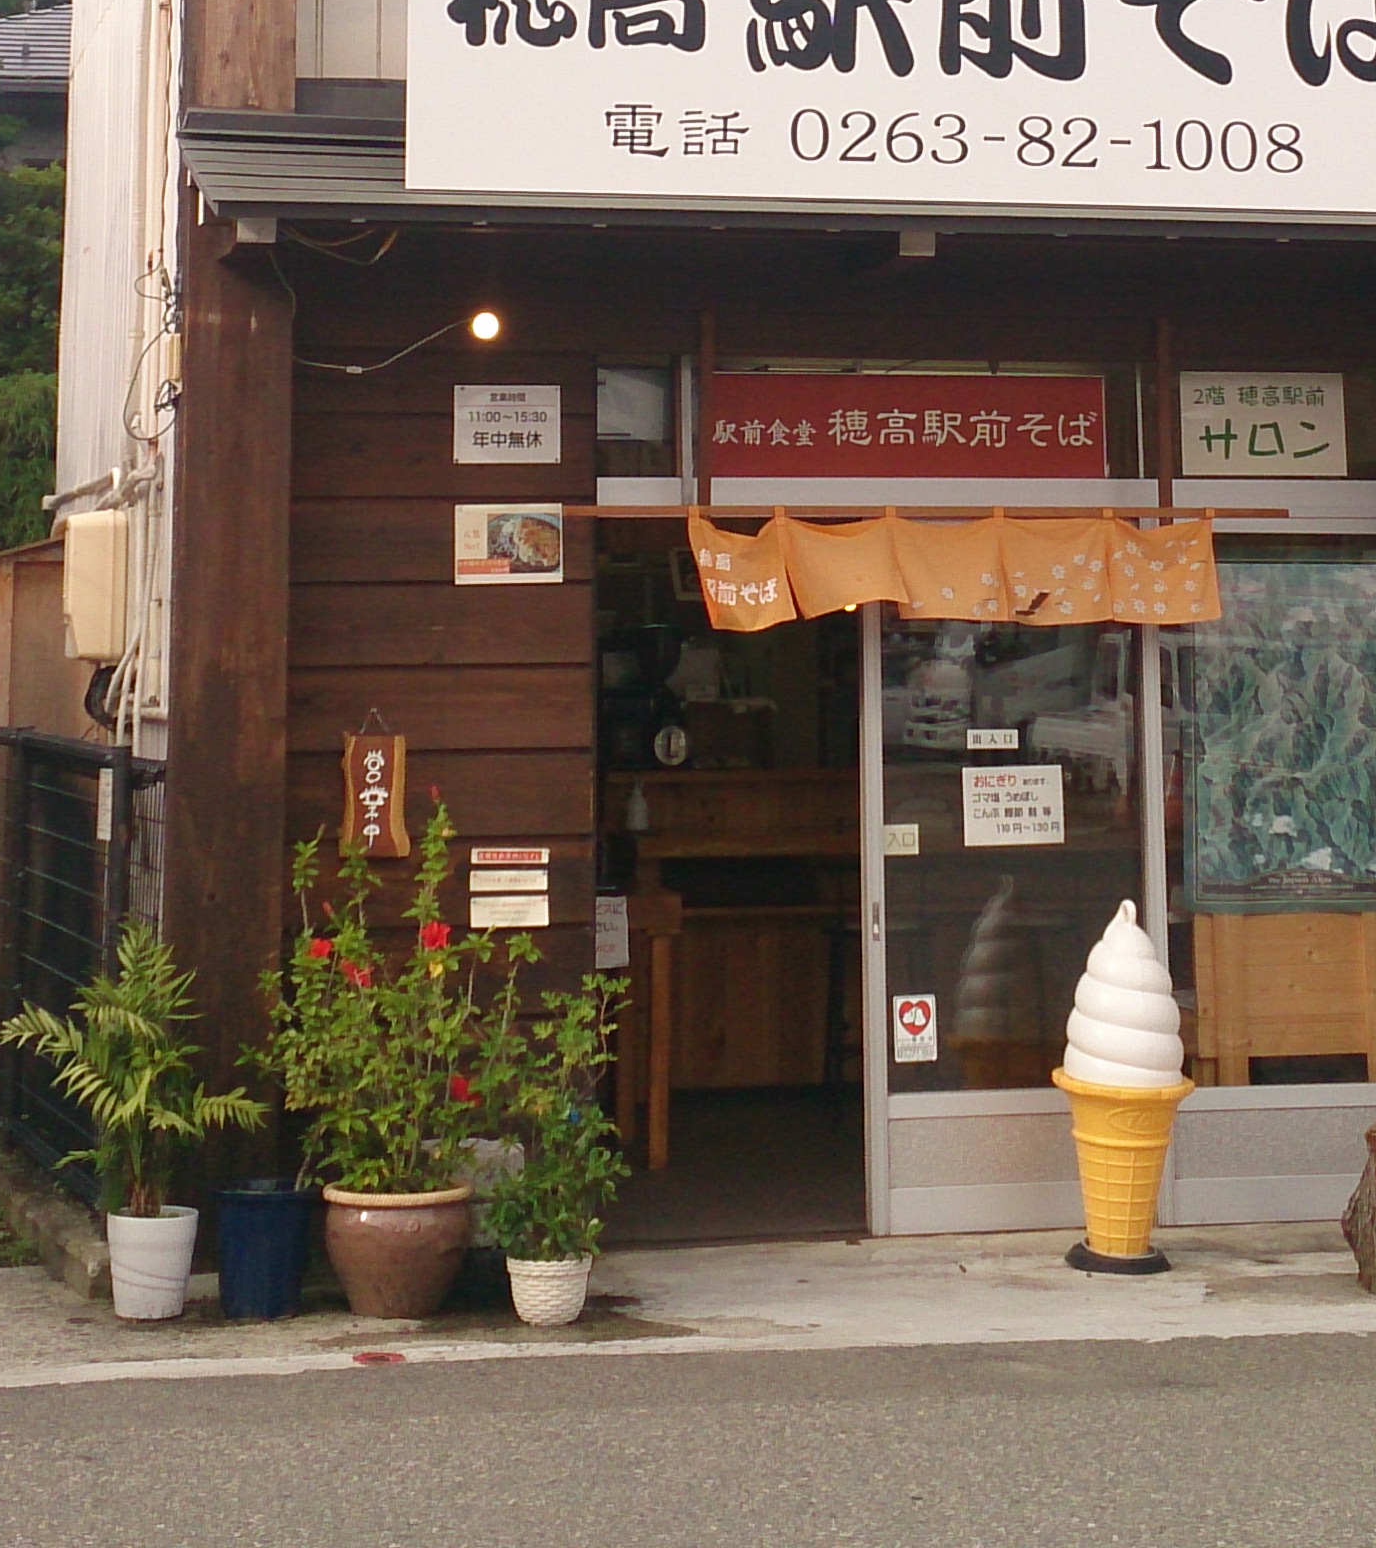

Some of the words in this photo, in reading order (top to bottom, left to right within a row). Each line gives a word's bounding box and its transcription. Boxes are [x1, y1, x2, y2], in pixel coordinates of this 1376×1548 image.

[603, 103, 750, 159] 電話
[789, 107, 1306, 174] 0263-82-1008
[490, 393, 526, 403] 営業時間
[1193, 386, 1225, 406] 2階
[1237, 385, 1325, 407] 穂高駅前
[712, 418, 817, 447] 駅前食堂
[827, 408, 1098, 448] 穂高駅前そば
[472, 431, 543, 448] 年中無休
[1199, 418, 1330, 460] サロン
[972, 733, 1013, 745] 出入口
[973, 774, 1017, 788] おにぎり
[359, 749, 389, 849] 営業中
[972, 792, 1000, 804] ゴマ塩
[973, 807, 1000, 819] こんぶ
[887, 832, 916, 848] 入口
